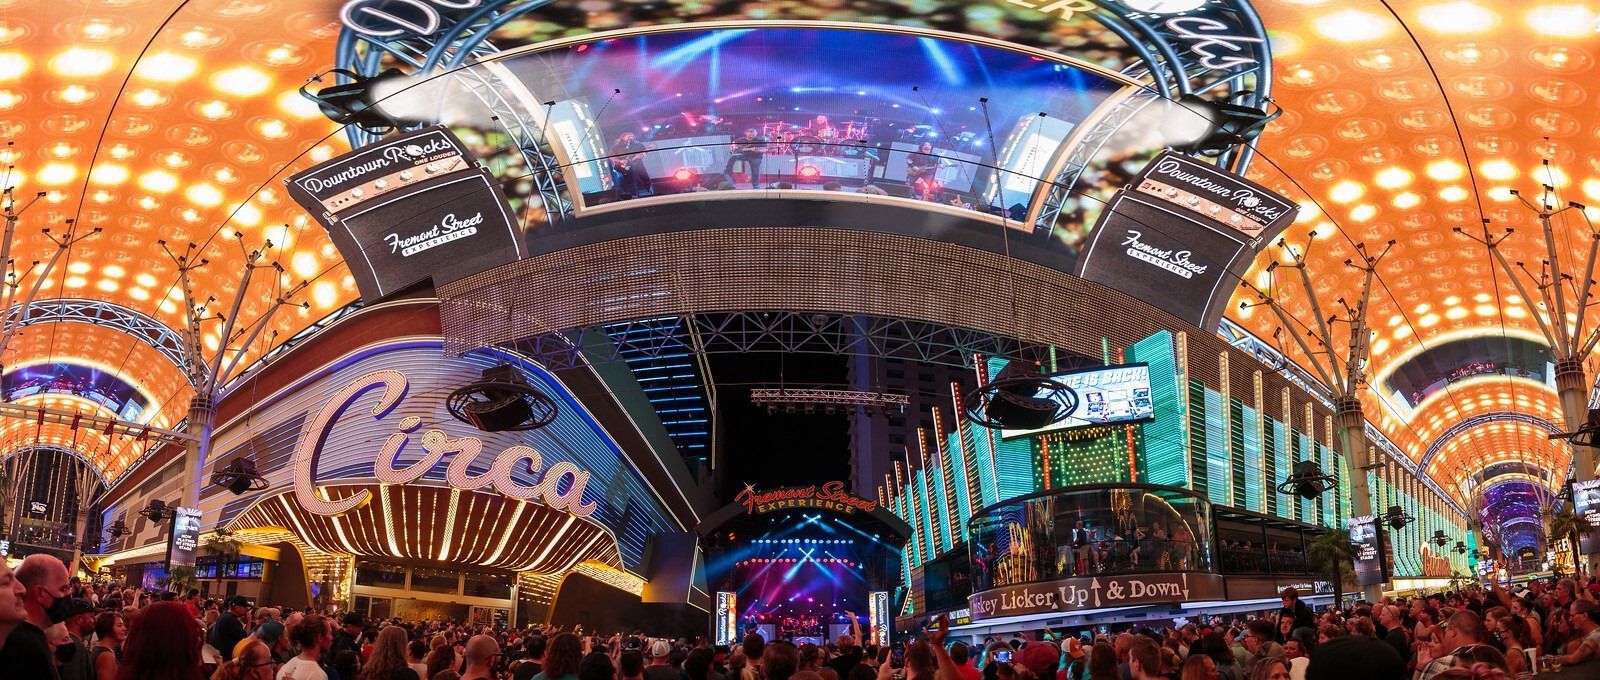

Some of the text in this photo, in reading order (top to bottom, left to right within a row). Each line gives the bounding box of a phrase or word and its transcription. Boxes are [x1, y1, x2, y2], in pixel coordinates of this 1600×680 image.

[304, 136, 452, 193] Downtown Rocks
[414, 158, 429, 166] ONE
[430, 150, 456, 162] LOUDER
[1158, 161, 1281, 220] Downtown Rocks
[384, 212, 483, 254] Fremont Street
[403, 227, 476, 256] EXPERIENCE
[1121, 229, 1208, 275] Fremont Street
[1128, 248, 1191, 278] EXPERIENCE
[294, 369, 597, 516] Circa
[735, 480, 878, 514] Fremont Street
[758, 499, 854, 513] EXPERIENCE
[1001, 589, 1052, 610] Licker
[1058, 584, 1089, 607] Up
[1106, 580, 1125, 600] &
[1128, 579, 1181, 598] Down
